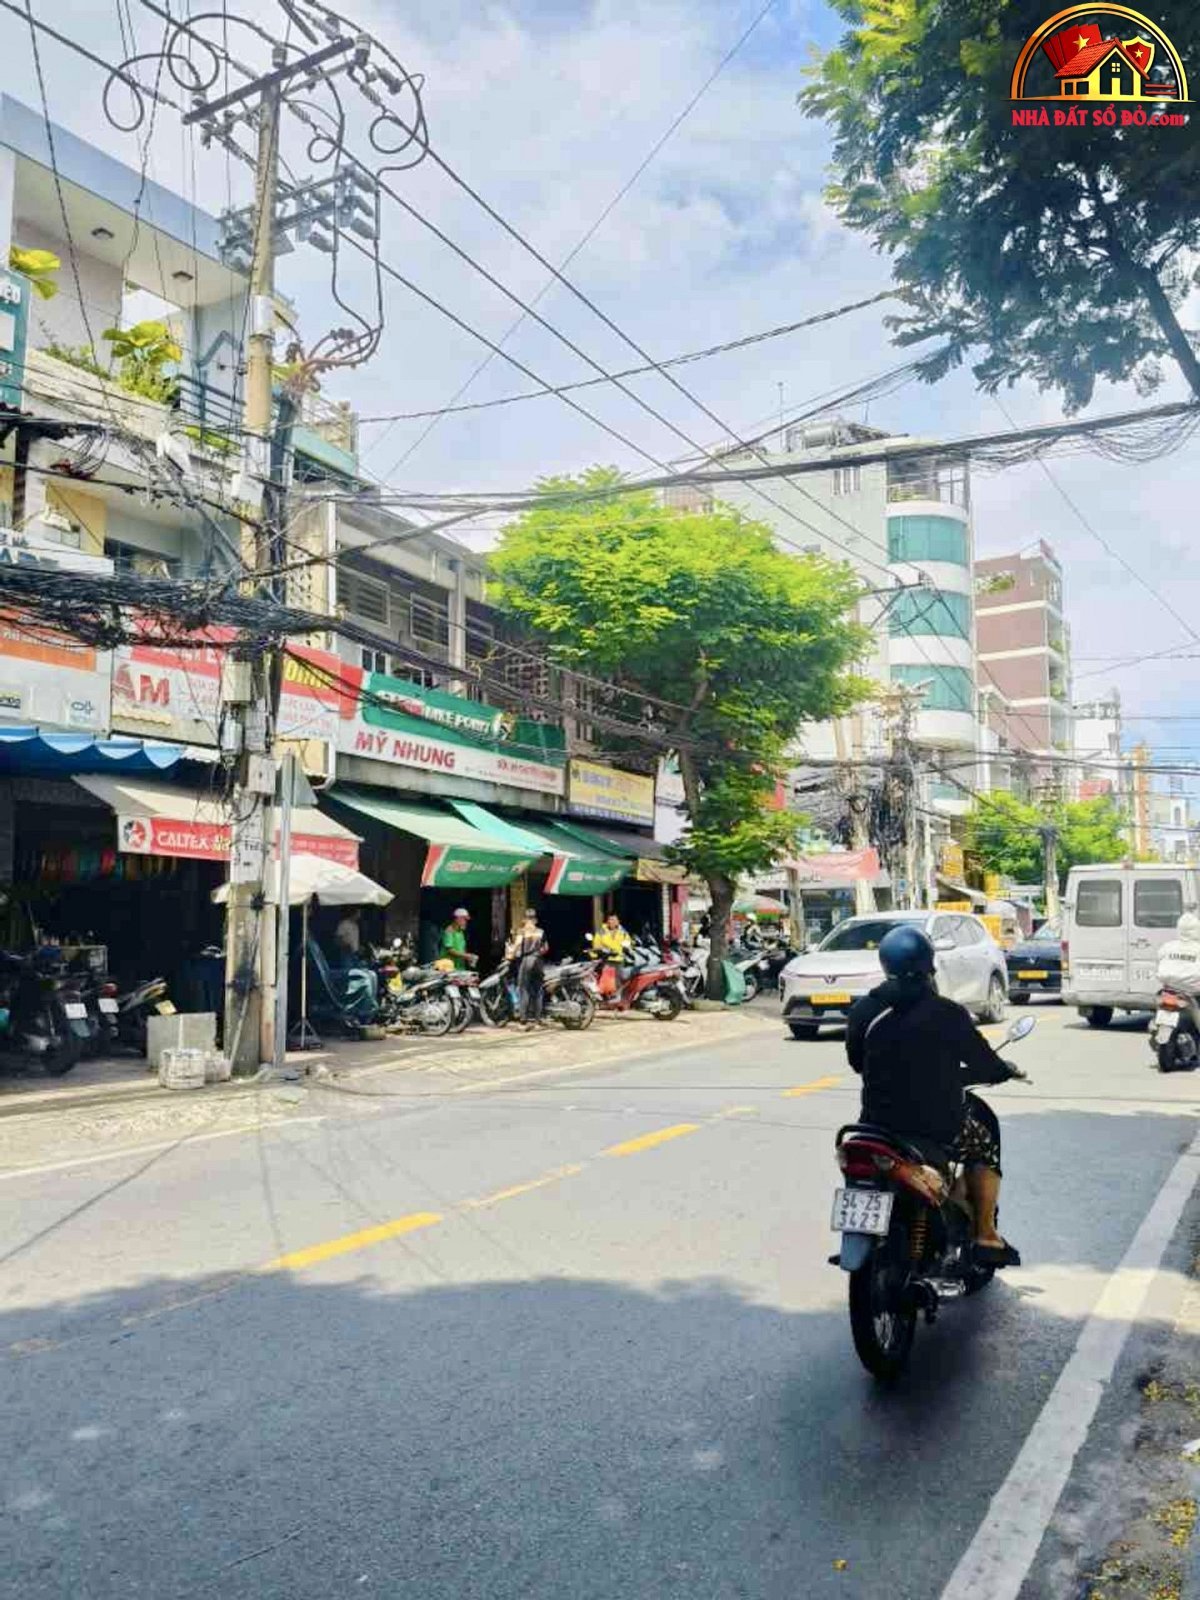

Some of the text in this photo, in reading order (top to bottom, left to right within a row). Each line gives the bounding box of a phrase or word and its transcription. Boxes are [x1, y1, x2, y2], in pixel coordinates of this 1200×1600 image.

[355, 729, 387, 751] MỸ
[392, 739, 456, 769] NHUNG
[156, 830, 209, 849] CALTEX
